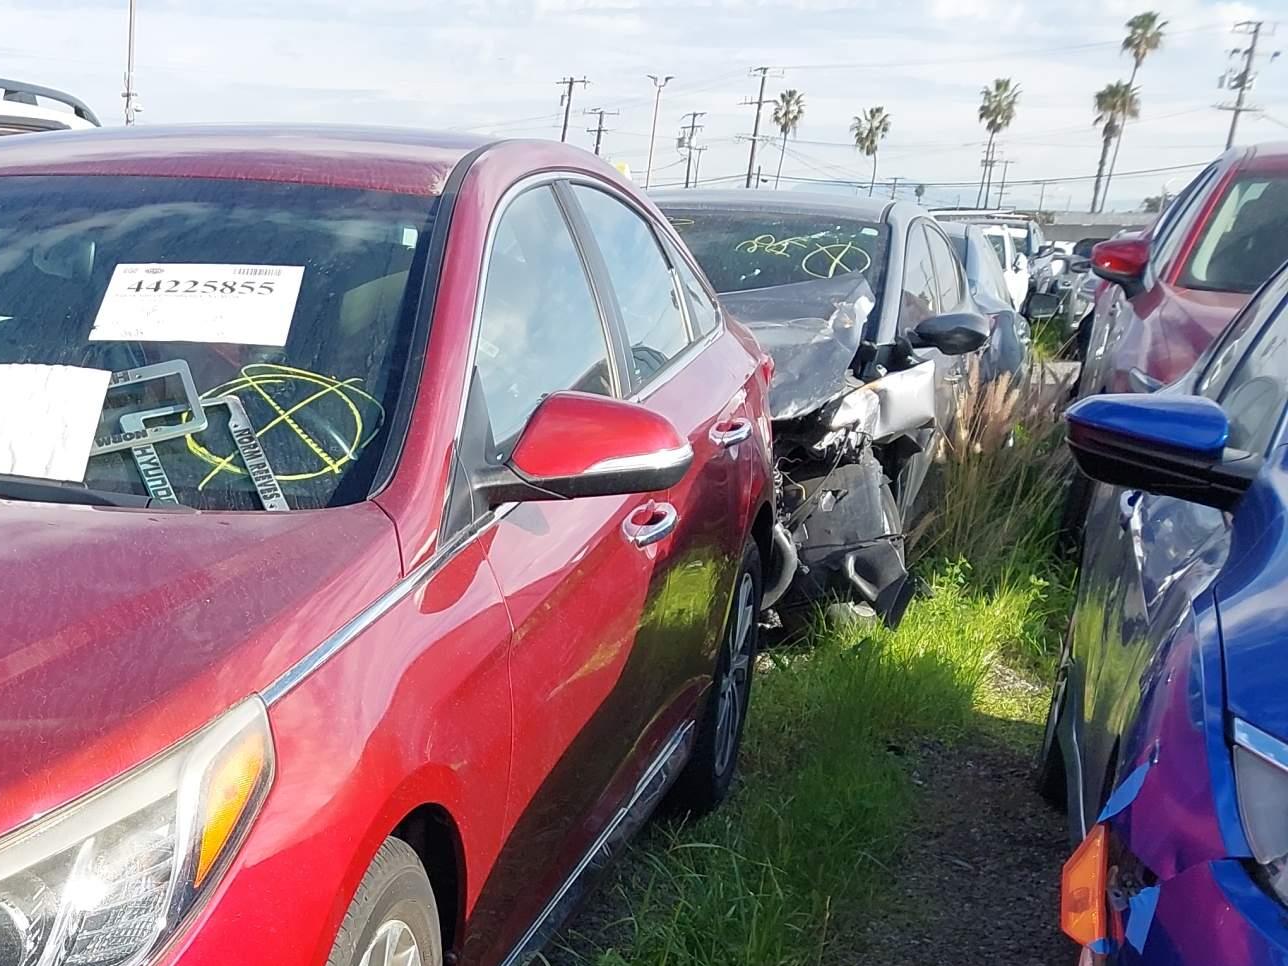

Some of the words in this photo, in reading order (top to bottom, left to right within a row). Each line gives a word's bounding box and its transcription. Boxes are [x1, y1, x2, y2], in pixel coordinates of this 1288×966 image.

[127, 278, 276, 296] 44225855
[96, 429, 148, 447] NORM
[234, 428, 263, 461] NORM
[249, 462, 281, 501] REEVES
